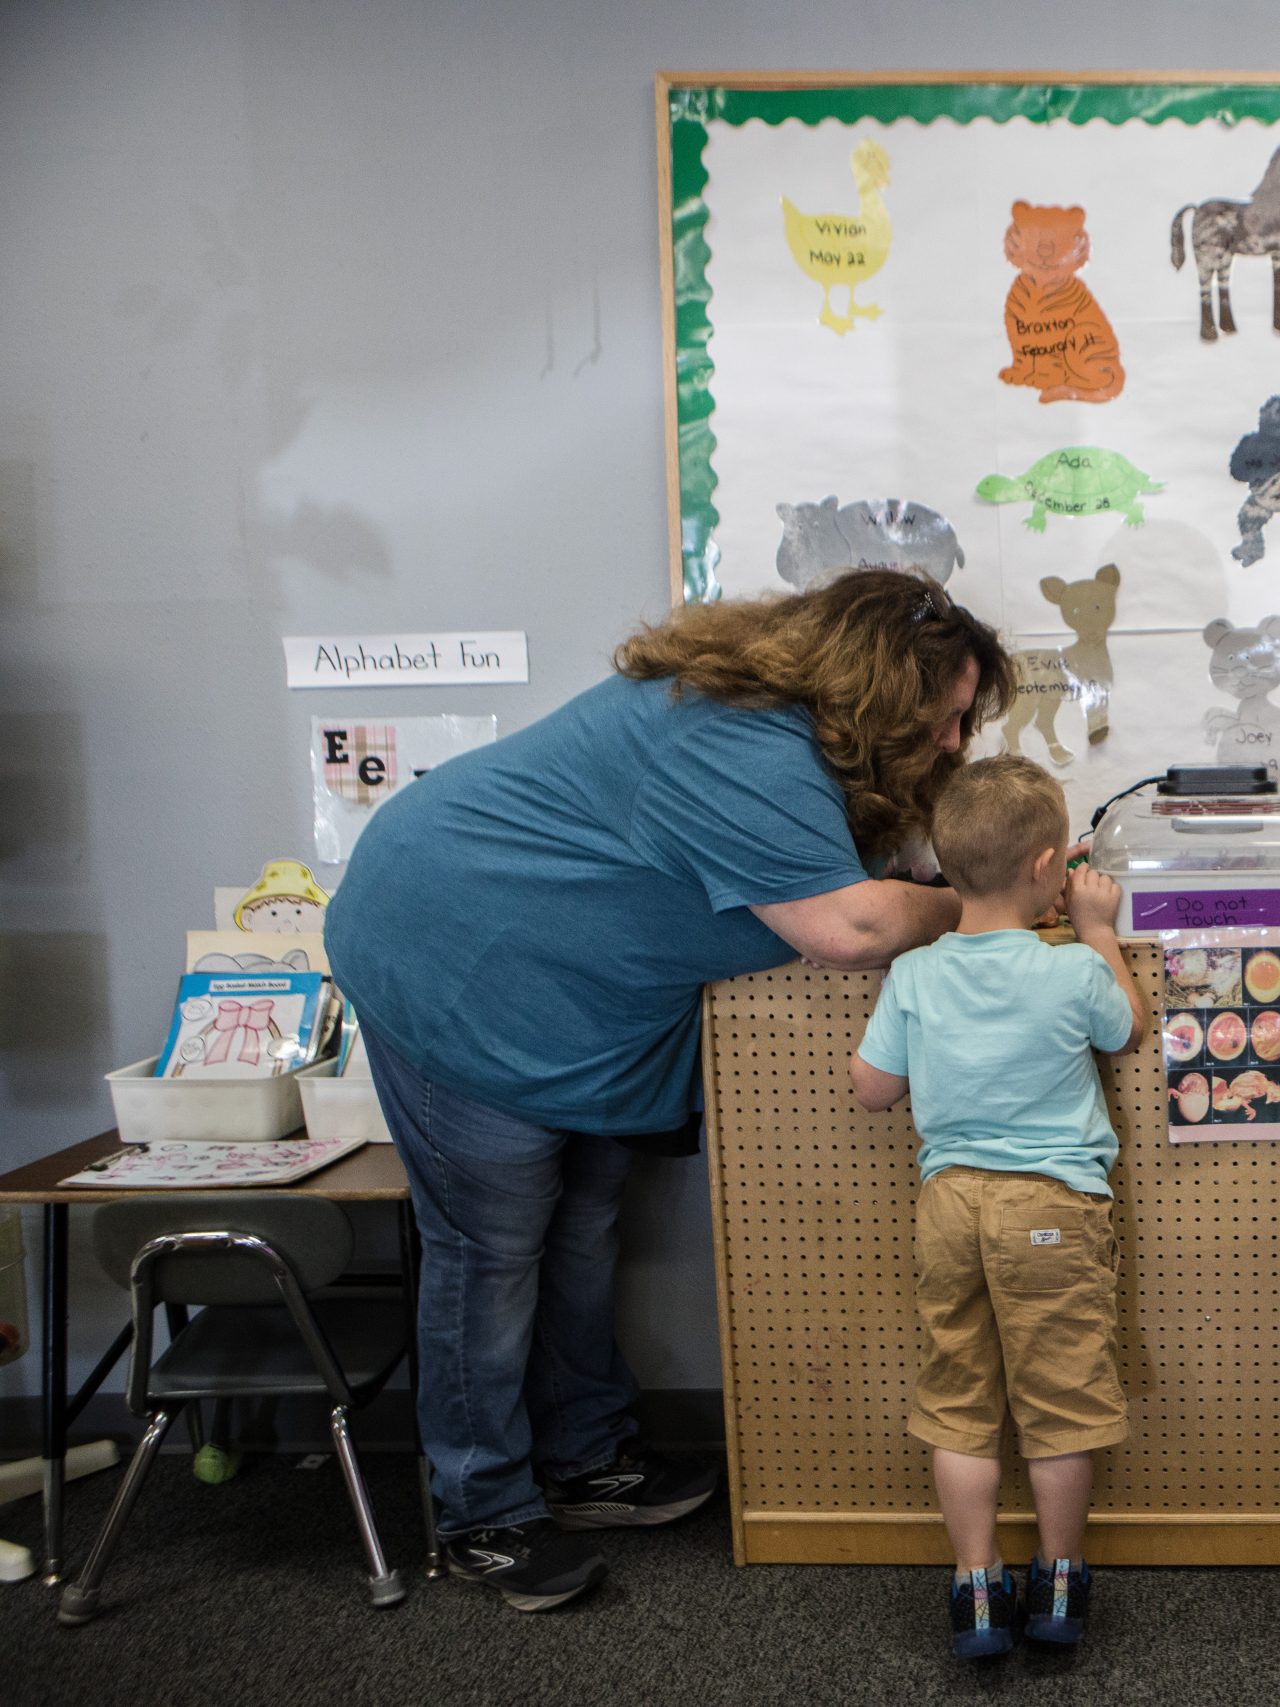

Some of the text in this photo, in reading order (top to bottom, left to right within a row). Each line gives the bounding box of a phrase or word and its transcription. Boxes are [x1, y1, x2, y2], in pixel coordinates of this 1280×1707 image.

[814, 218, 867, 236] Vivian
[809, 249, 866, 268] May 22
[1015, 317, 1076, 335] Braxton
[1055, 452, 1093, 469] Ada
[313, 640, 501, 680] Alphabet Fun
[1235, 728, 1273, 747] Joey
[1175, 896, 1248, 912] Do not
[1178, 911, 1238, 927] touch
